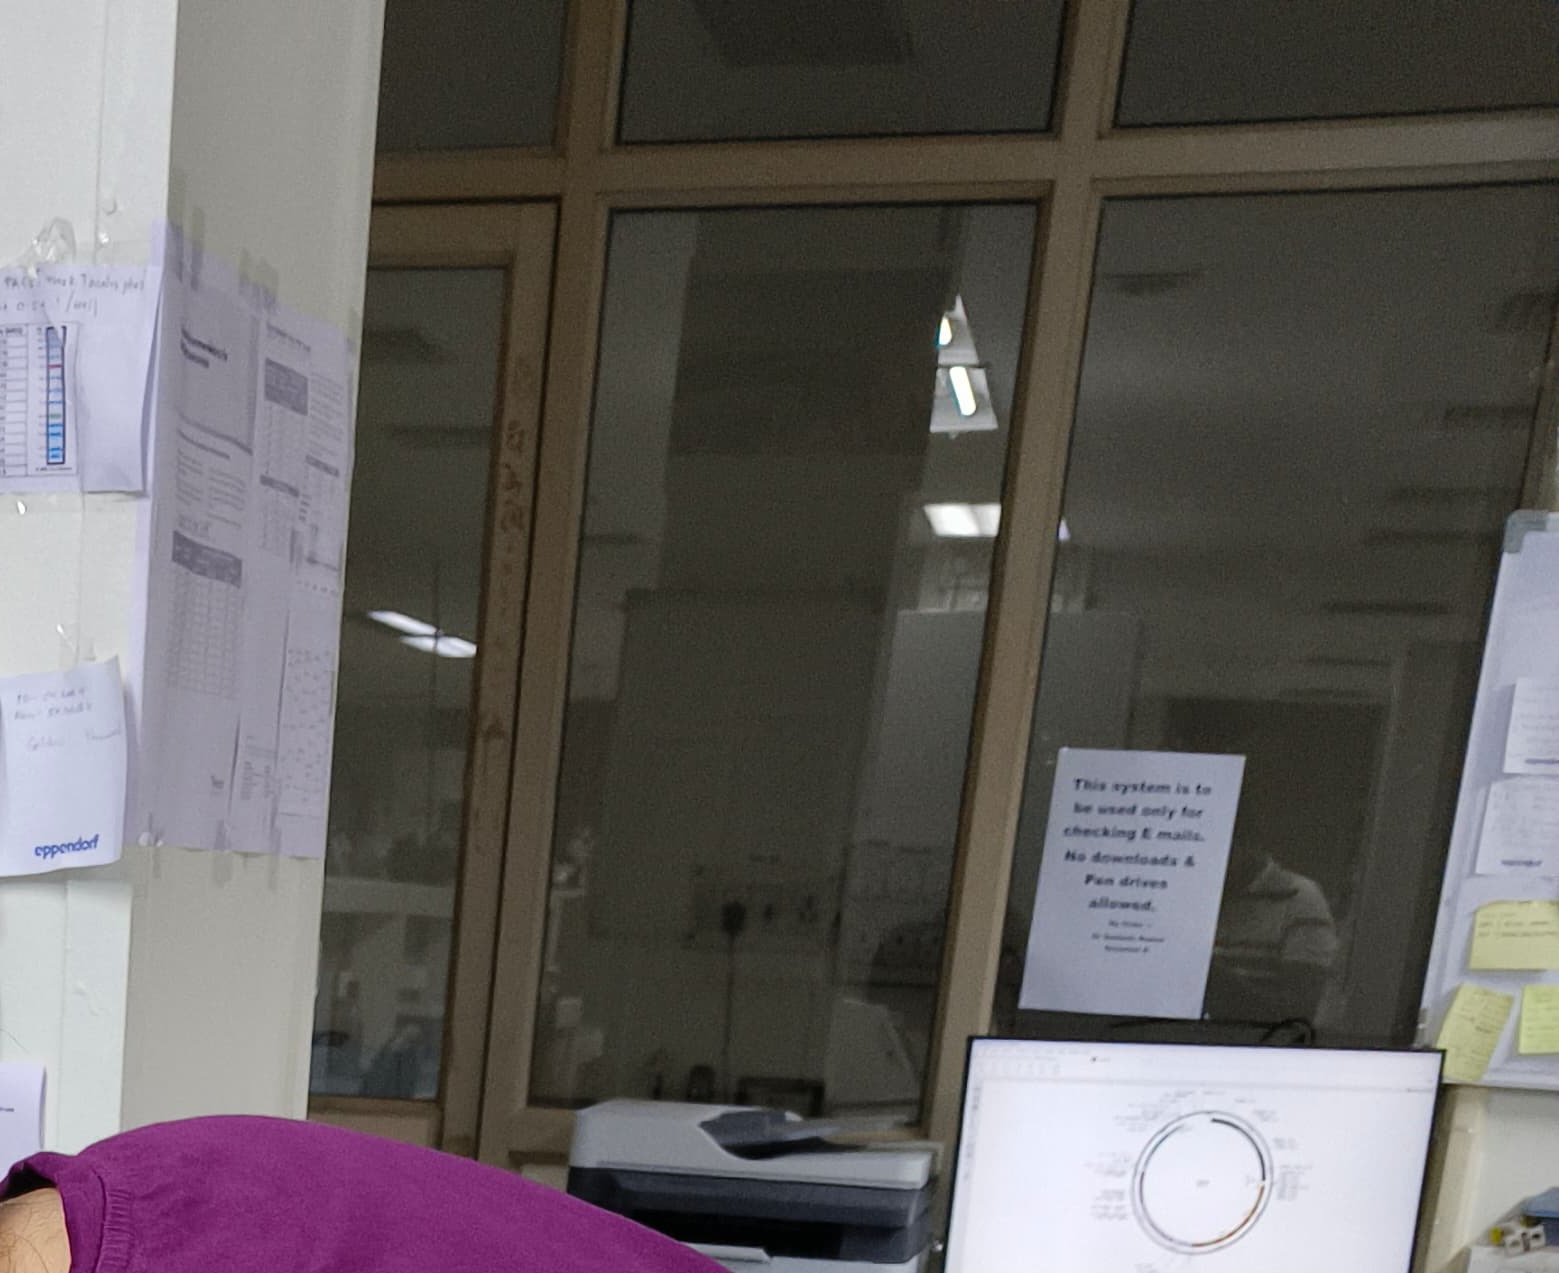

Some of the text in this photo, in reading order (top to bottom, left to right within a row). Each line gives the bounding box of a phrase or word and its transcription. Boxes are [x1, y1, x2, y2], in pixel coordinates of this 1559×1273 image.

[1075, 778, 1212, 795] This system is to
[1074, 802, 1203, 820] be used only for
[1064, 826, 1136, 842] checking
[1142, 827, 1152, 840] E
[34, 834, 99, 860] eppendorf
[1064, 850, 1086, 862] No
[1092, 851, 1176, 867] downloads
[1085, 874, 1167, 889] Pen drives
